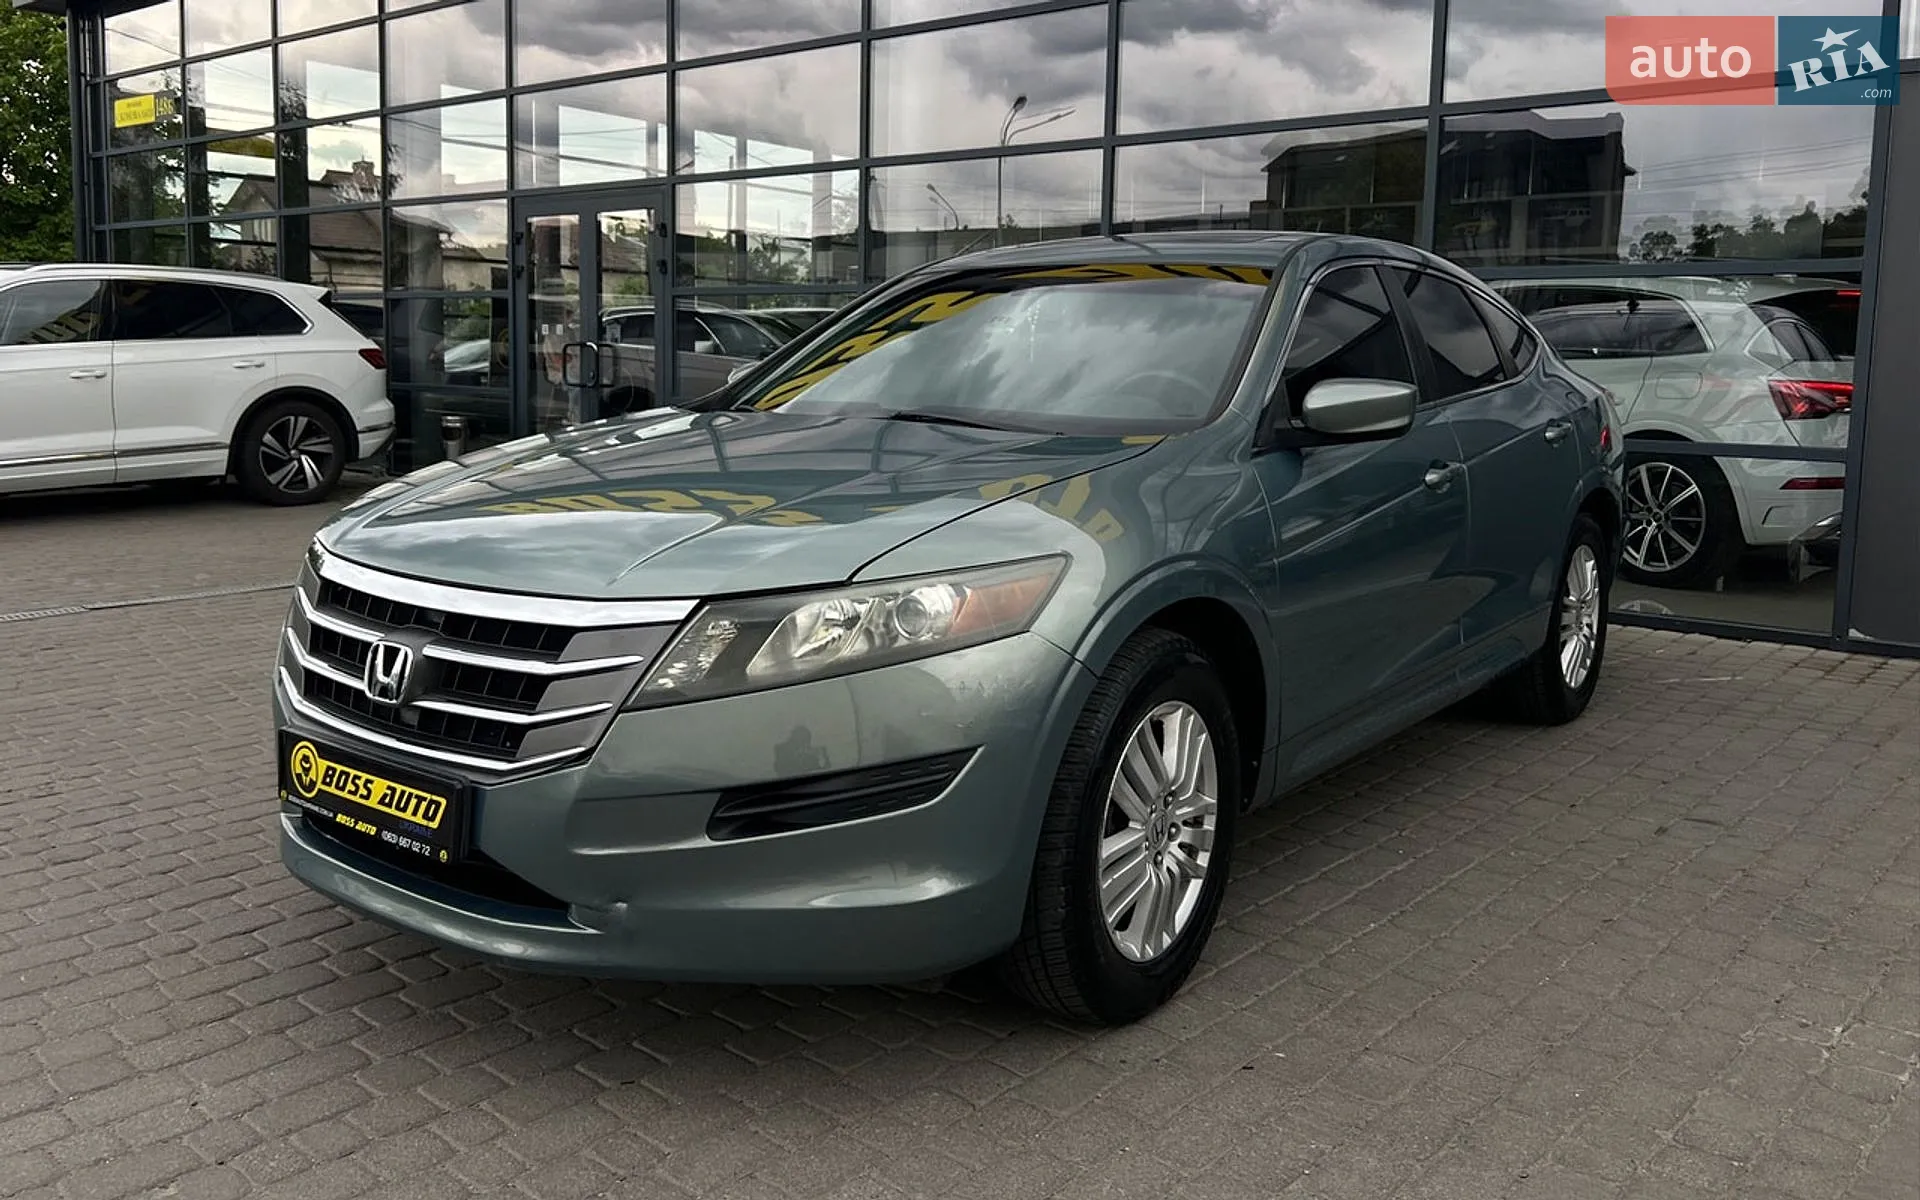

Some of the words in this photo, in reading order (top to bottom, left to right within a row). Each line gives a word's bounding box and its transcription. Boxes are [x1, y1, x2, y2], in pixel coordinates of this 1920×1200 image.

[322, 765, 374, 801] BOSS
[377, 784, 442, 823] AUTO
[336, 813, 355, 828] BOSS
[355, 820, 378, 836] AUTO
[421, 843, 431, 857] 72
